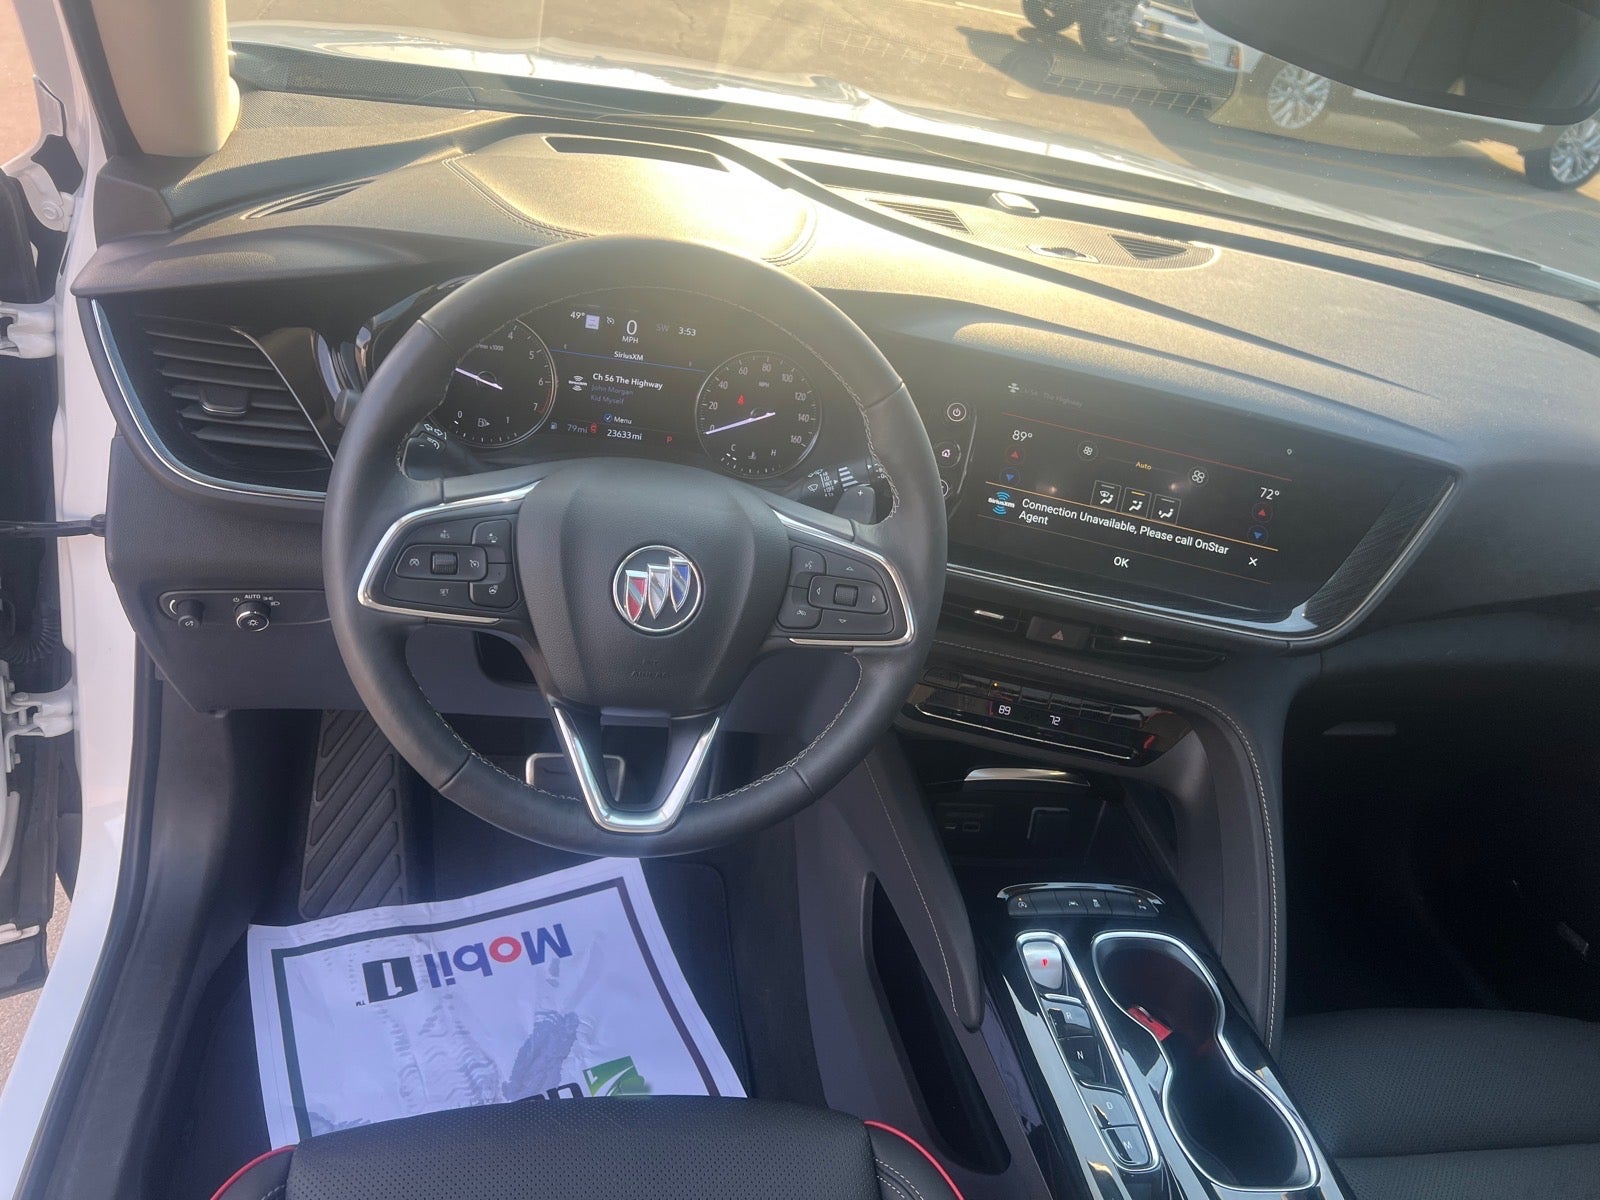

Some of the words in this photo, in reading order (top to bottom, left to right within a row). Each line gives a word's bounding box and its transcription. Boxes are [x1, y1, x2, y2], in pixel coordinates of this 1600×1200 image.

[626, 319, 638, 336] 0
[656, 323, 670, 332] SW
[678, 326, 697, 337] 3:53
[507, 331, 514, 340] 4
[621, 335, 639, 344] MPH
[528, 350, 535, 360] 5
[613, 350, 645, 361] SiriusXM
[738, 366, 748, 376] 60
[762, 363, 772, 372] 80
[538, 377, 544, 386] 6
[592, 372, 604, 381] Ch
[604, 373, 615, 383] 56
[615, 375, 630, 385] The
[631, 378, 664, 391] Highway
[781, 373, 794, 383] 100
[718, 380, 729, 390] 40
[758, 381, 770, 389] MPH
[794, 391, 807, 401] 120
[533, 402, 539, 411] 7
[708, 401, 718, 411] 20
[457, 410, 463, 419] 0
[798, 413, 810, 423] 140
[613, 415, 633, 425] Menu
[666, 435, 673, 444] P
[790, 434, 802, 444] 160
[1012, 429, 1033, 442] 89°
[730, 443, 737, 452] C
[770, 448, 777, 457] H
[1135, 460, 1152, 471] Auto
[1259, 486, 1280, 501] 72°
[1018, 510, 1050, 526] Agent
[1021, 498, 1078, 520] Connection
[1079, 511, 1137, 535] Unavailable,
[1139, 525, 1174, 542] Please
[1174, 534, 1194, 547] call
[1194, 538, 1230, 555] OnStar
[1113, 556, 1131, 569] OK
[998, 704, 1012, 716] 89
[1049, 714, 1061, 726] 72
[423, 923, 573, 989] Mobil
[1065, 1011, 1073, 1020] R
[1076, 1049, 1084, 1060] N
